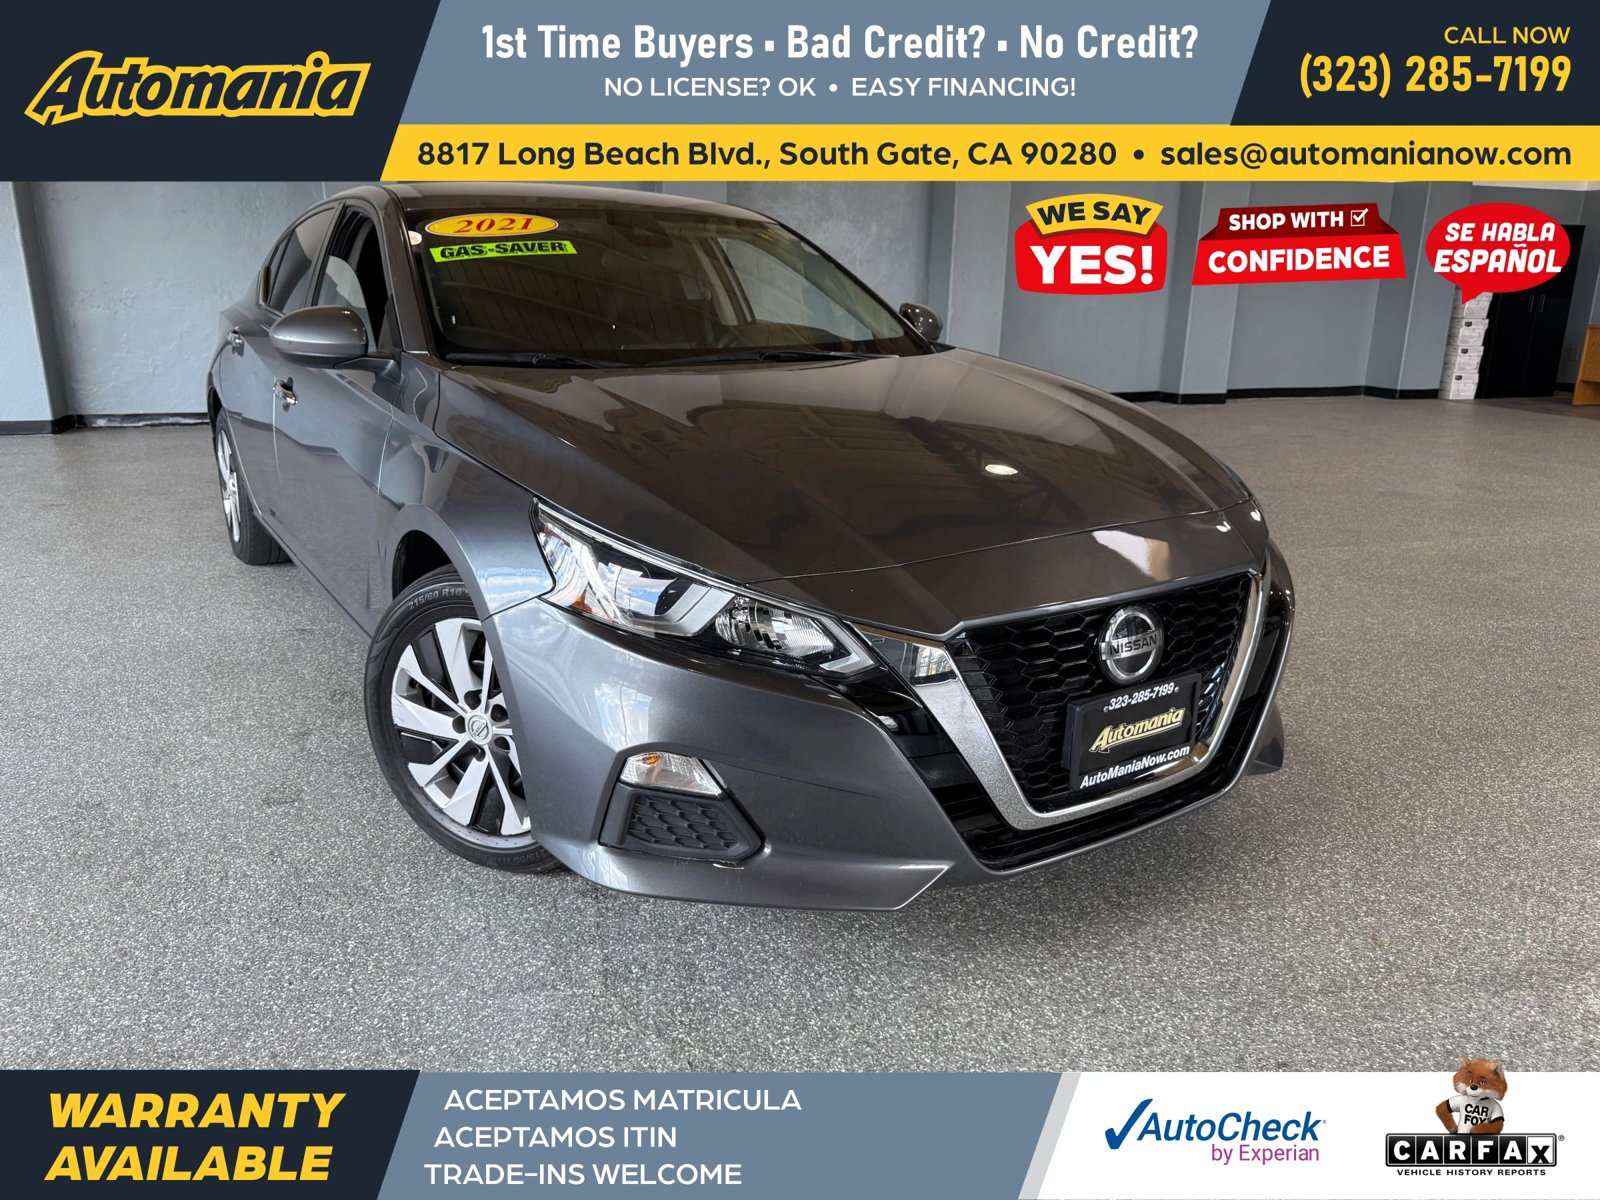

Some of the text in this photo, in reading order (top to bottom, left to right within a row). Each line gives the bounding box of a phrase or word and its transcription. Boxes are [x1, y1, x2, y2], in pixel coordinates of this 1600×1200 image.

[453, 217, 533, 233] 2021
[440, 242, 566, 259] GAS-SAVER
[408, 590, 439, 610] 215/60
[1109, 633, 1158, 656] NISSAN
[1108, 682, 1175, 711] 323-285-7199
[1088, 707, 1187, 753] Automania
[1080, 745, 1191, 789] AutoManiaNow.com
